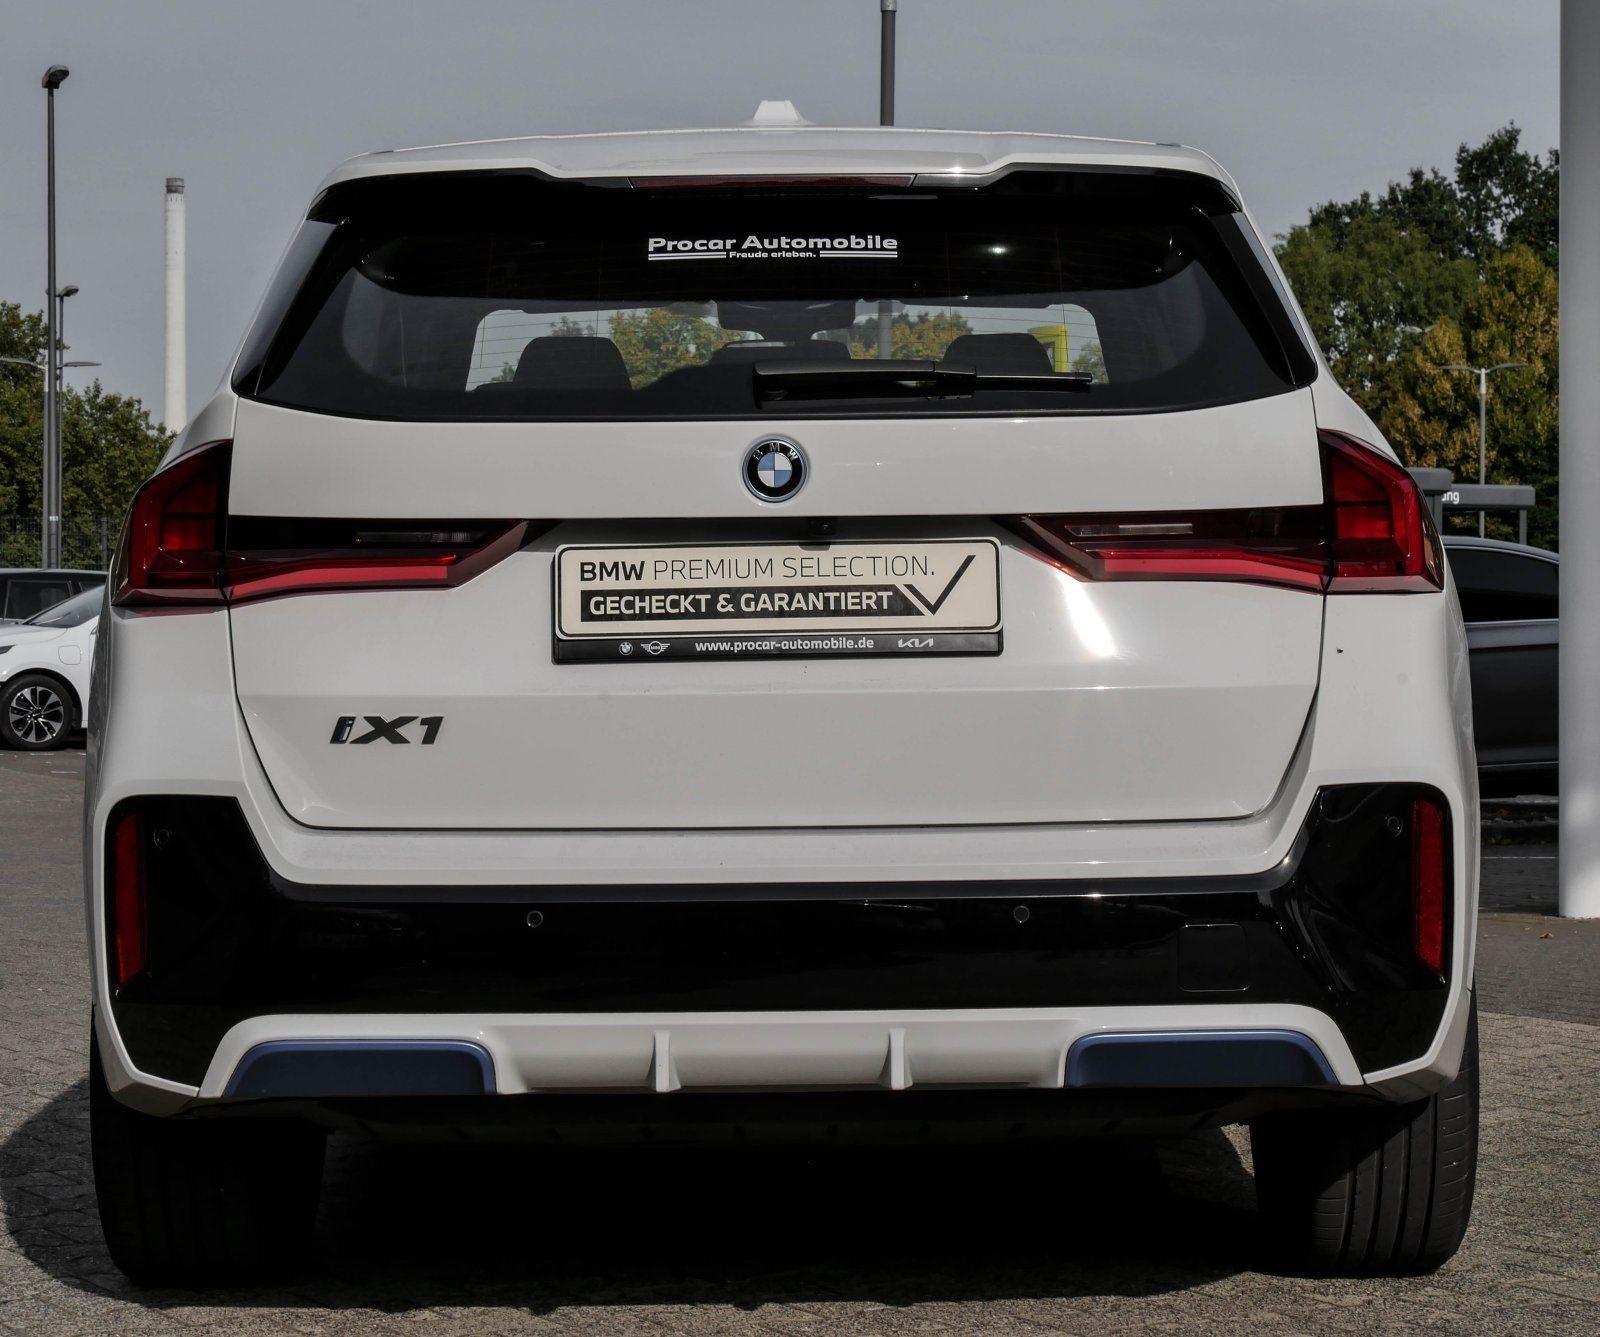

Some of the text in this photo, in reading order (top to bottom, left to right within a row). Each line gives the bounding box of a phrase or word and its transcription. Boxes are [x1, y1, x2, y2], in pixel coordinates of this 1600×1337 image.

[649, 235, 898, 251] Procar Automobile
[771, 250, 816, 258] erleben.
[752, 442, 798, 461] BMW
[580, 555, 935, 581] BMW PREMIUM SELECTION.
[589, 591, 893, 615] GECHECKT & GARANTIERT
[695, 637, 874, 652] www.procar-automobile.de
[330, 716, 444, 744] iX1
